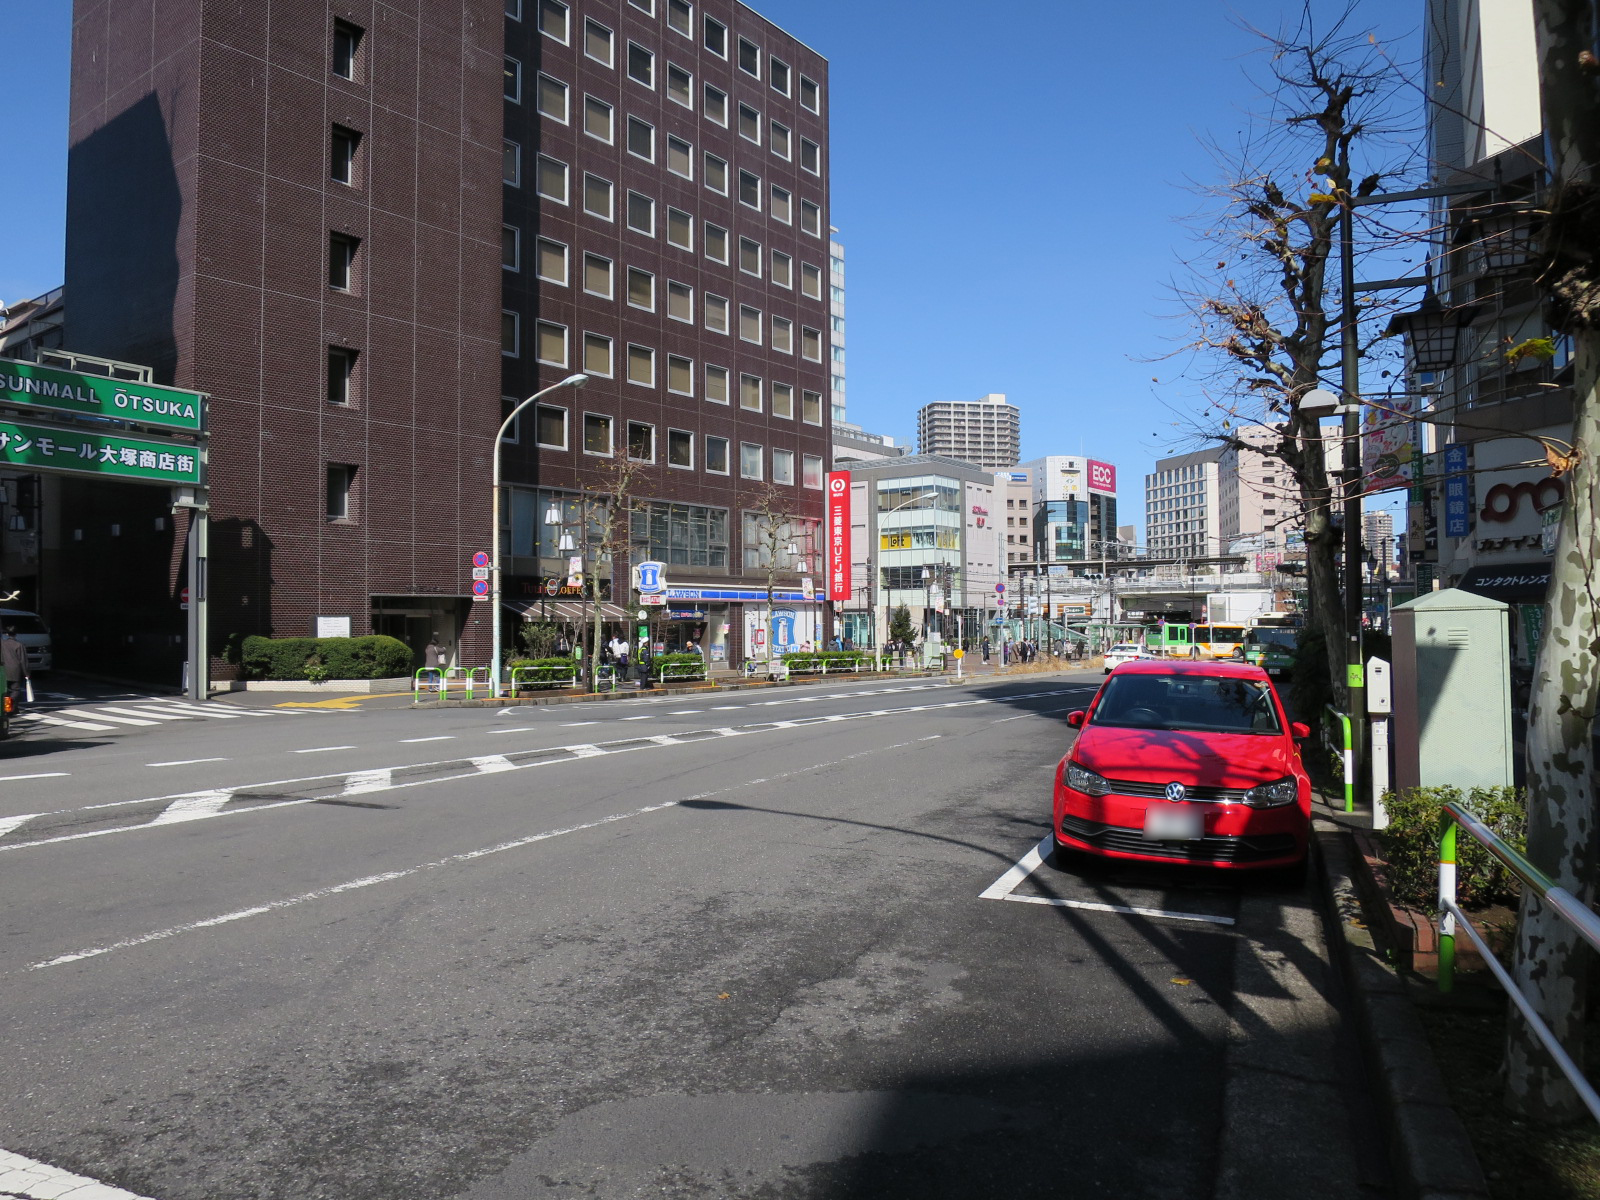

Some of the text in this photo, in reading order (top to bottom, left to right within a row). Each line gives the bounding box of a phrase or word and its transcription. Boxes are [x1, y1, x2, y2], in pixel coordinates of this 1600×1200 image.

[0, 373, 102, 404] SUNMALL
[1092, 465, 1112, 484] ECC
[834, 505, 844, 593] 三菱東京UFJ銀行
[890, 536, 904, 548] Loft
[1476, 574, 1552, 586] コンタクトレンズ
[668, 590, 700, 598] LAWSON
